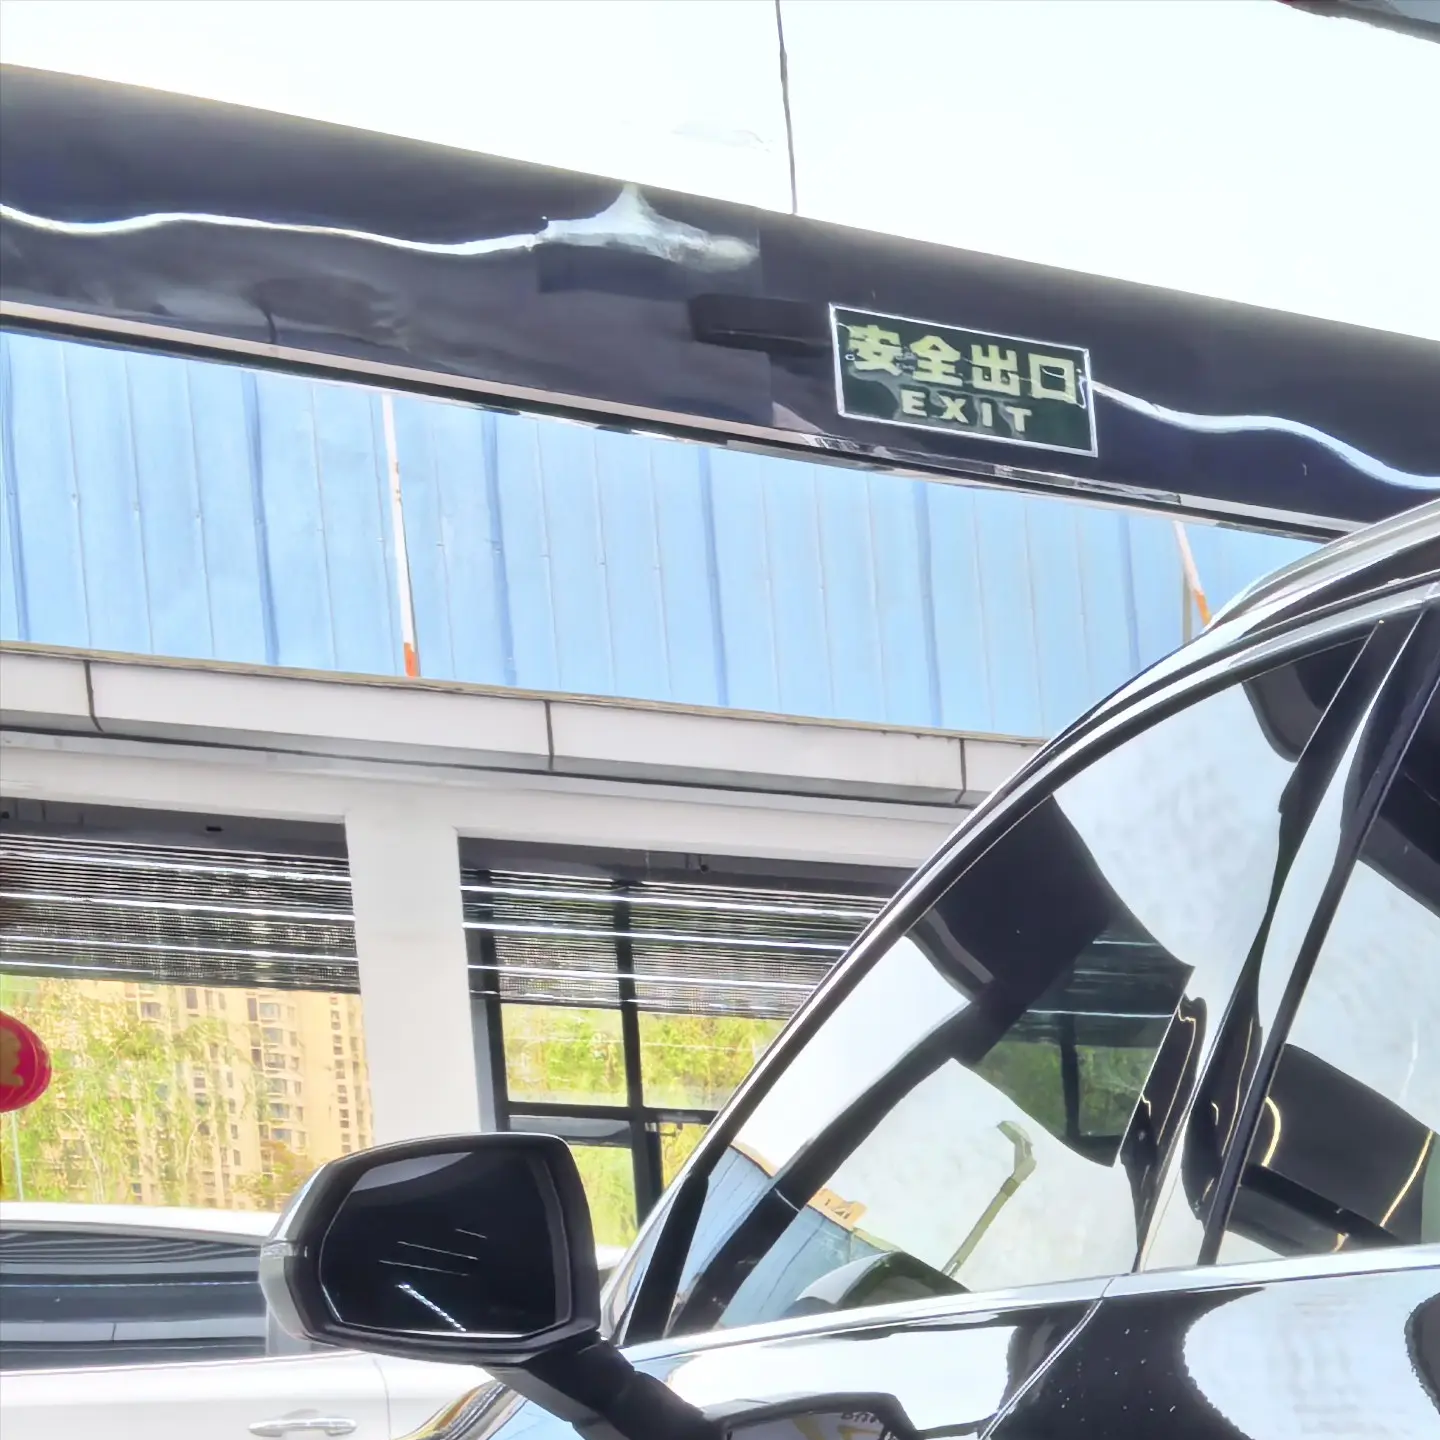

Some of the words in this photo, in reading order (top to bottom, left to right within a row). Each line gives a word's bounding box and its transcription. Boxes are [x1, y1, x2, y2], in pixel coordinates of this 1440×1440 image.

[849, 325, 1077, 405] 安全出口
[901, 390, 1032, 433] EXIT
